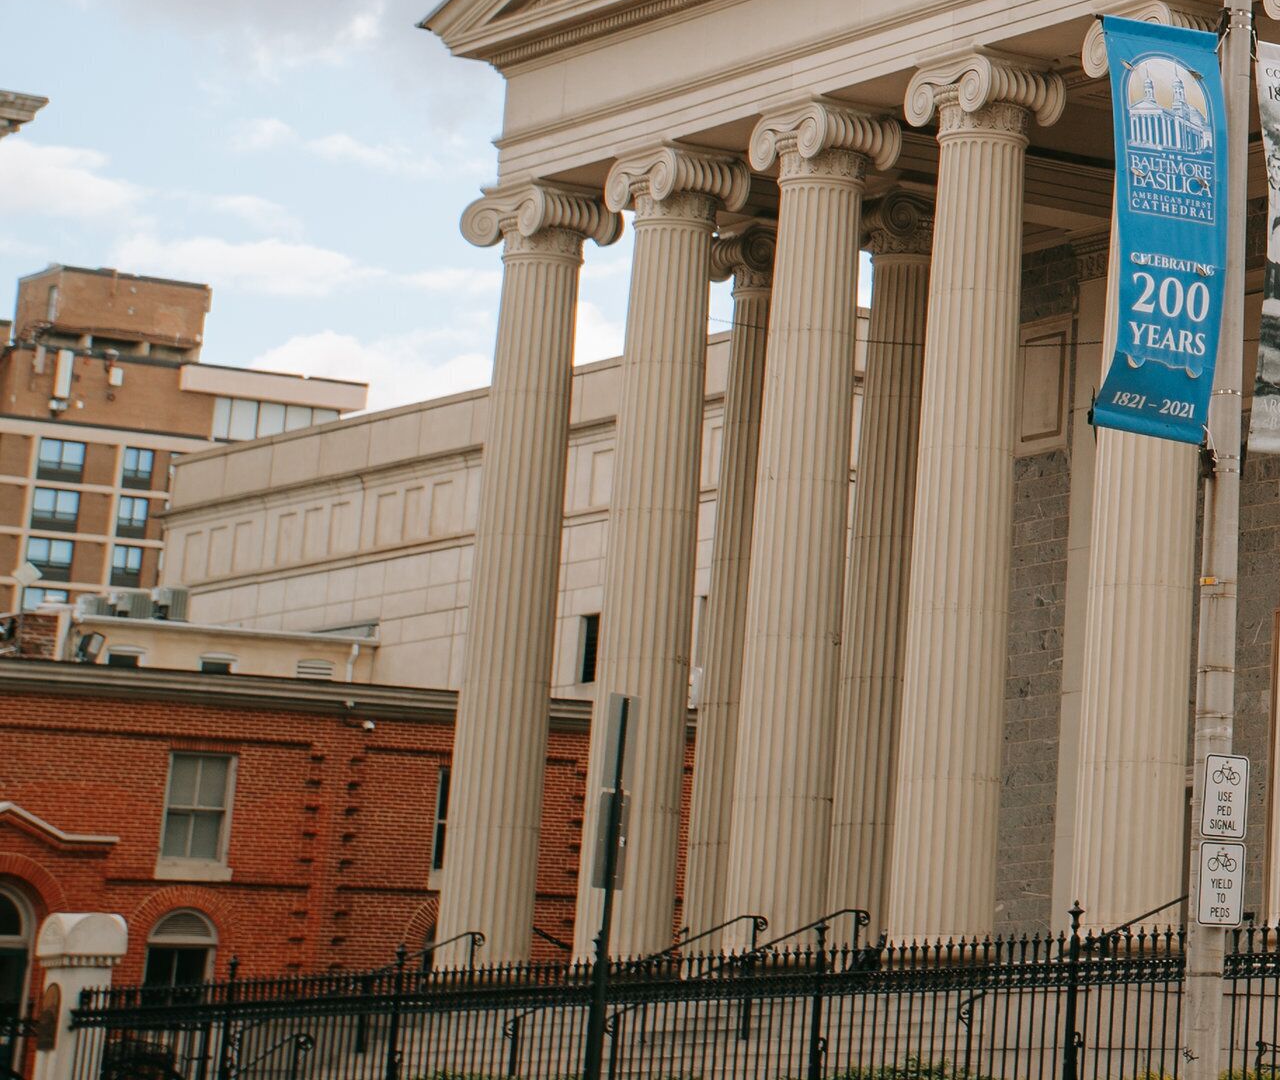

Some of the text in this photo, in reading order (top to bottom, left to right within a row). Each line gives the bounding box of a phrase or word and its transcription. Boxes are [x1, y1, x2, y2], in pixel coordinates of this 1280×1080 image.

[1161, 153, 1183, 161] THE
[1131, 155, 1212, 180] BALTIMORE
[1132, 170, 1213, 198] BASILICA
[1132, 191, 1212, 210] AMERICA'S FIRST
[1132, 198, 1214, 220] CATHEDRAL
[1131, 252, 1215, 277] CELEBRATING
[1131, 272, 1210, 323] 200
[1129, 321, 1207, 356] YEARS
[1112, 391, 1147, 410] 1821
[1159, 399, 1195, 419] 2021
[1217, 791, 1233, 803] USE
[1216, 805, 1232, 817] PED
[1209, 819, 1237, 831] SIGNAL
[1210, 878, 1233, 890] YIELD
[1216, 893, 1226, 904] TO
[1210, 907, 1230, 918] PEDS
